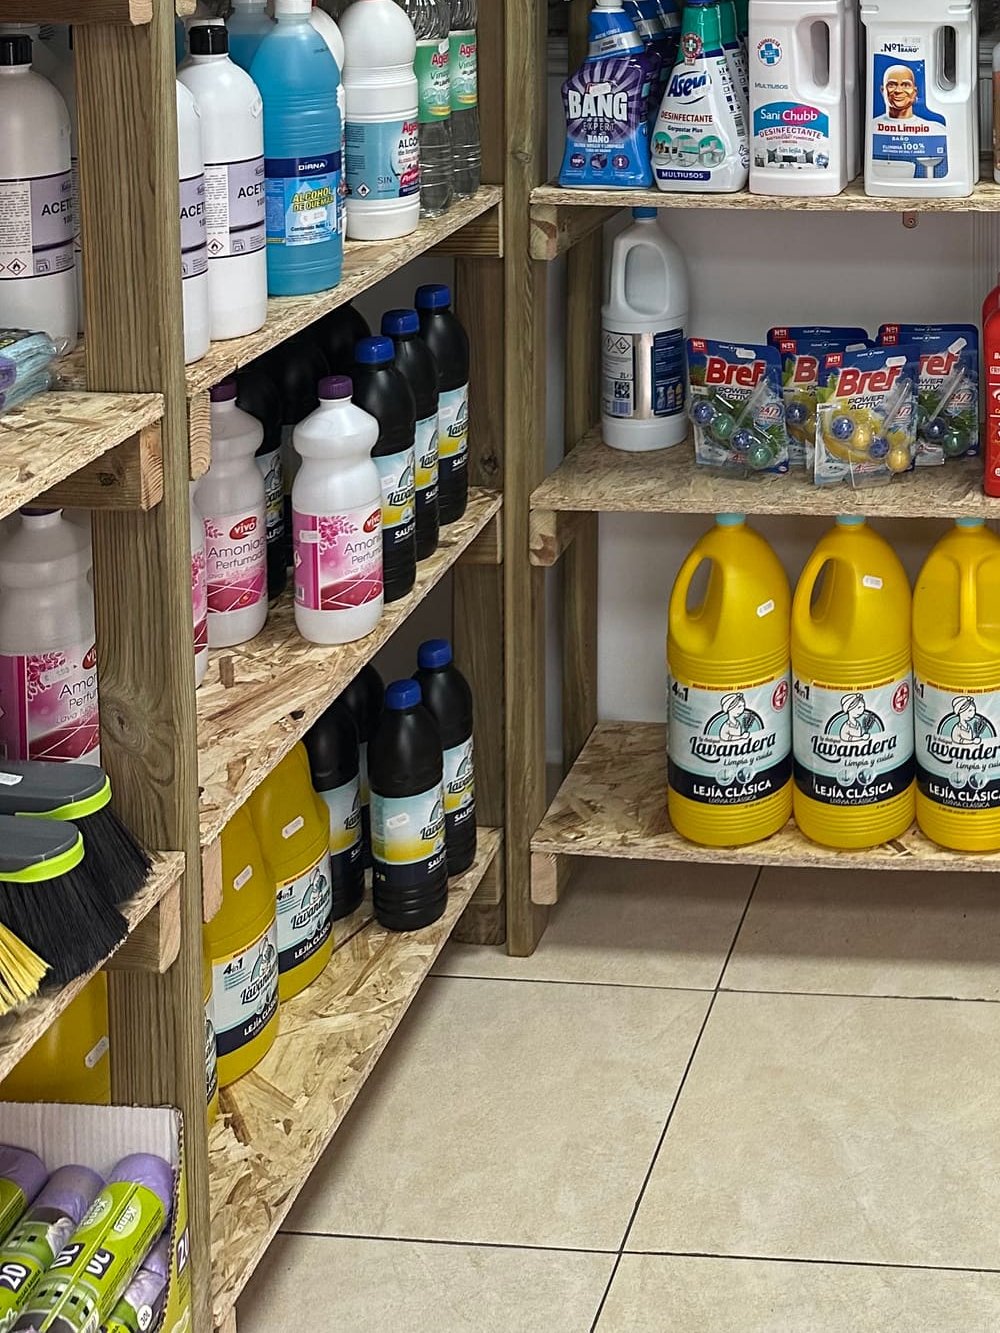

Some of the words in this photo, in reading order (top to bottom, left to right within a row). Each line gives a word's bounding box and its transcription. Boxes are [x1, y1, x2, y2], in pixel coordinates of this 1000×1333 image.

[568, 90, 628, 121] BANG
[660, 111, 713, 123] DESINFECTANTE
[760, 110, 781, 120] Sani
[782, 110, 818, 121] Chubb
[877, 124, 894, 133] Don
[896, 123, 930, 134] Limpio
[662, 171, 703, 179] MULTIUSOS
[292, 187, 332, 203] ALCOHOL
[706, 357, 765, 387] Bref
[836, 366, 901, 397] Bref
[234, 522, 257, 535] vivo
[690, 732, 776, 763] Lavandera
[811, 732, 897, 765] Lavandera
[694, 782, 724, 797] LEJÍA
[725, 780, 772, 797] CLÁSICA
[815, 783, 844, 797] LEJÍA
[846, 782, 893, 798] CLÁSICA
[929, 783, 956, 799] LEJÍA
[223, 958, 244, 975] 4in1
